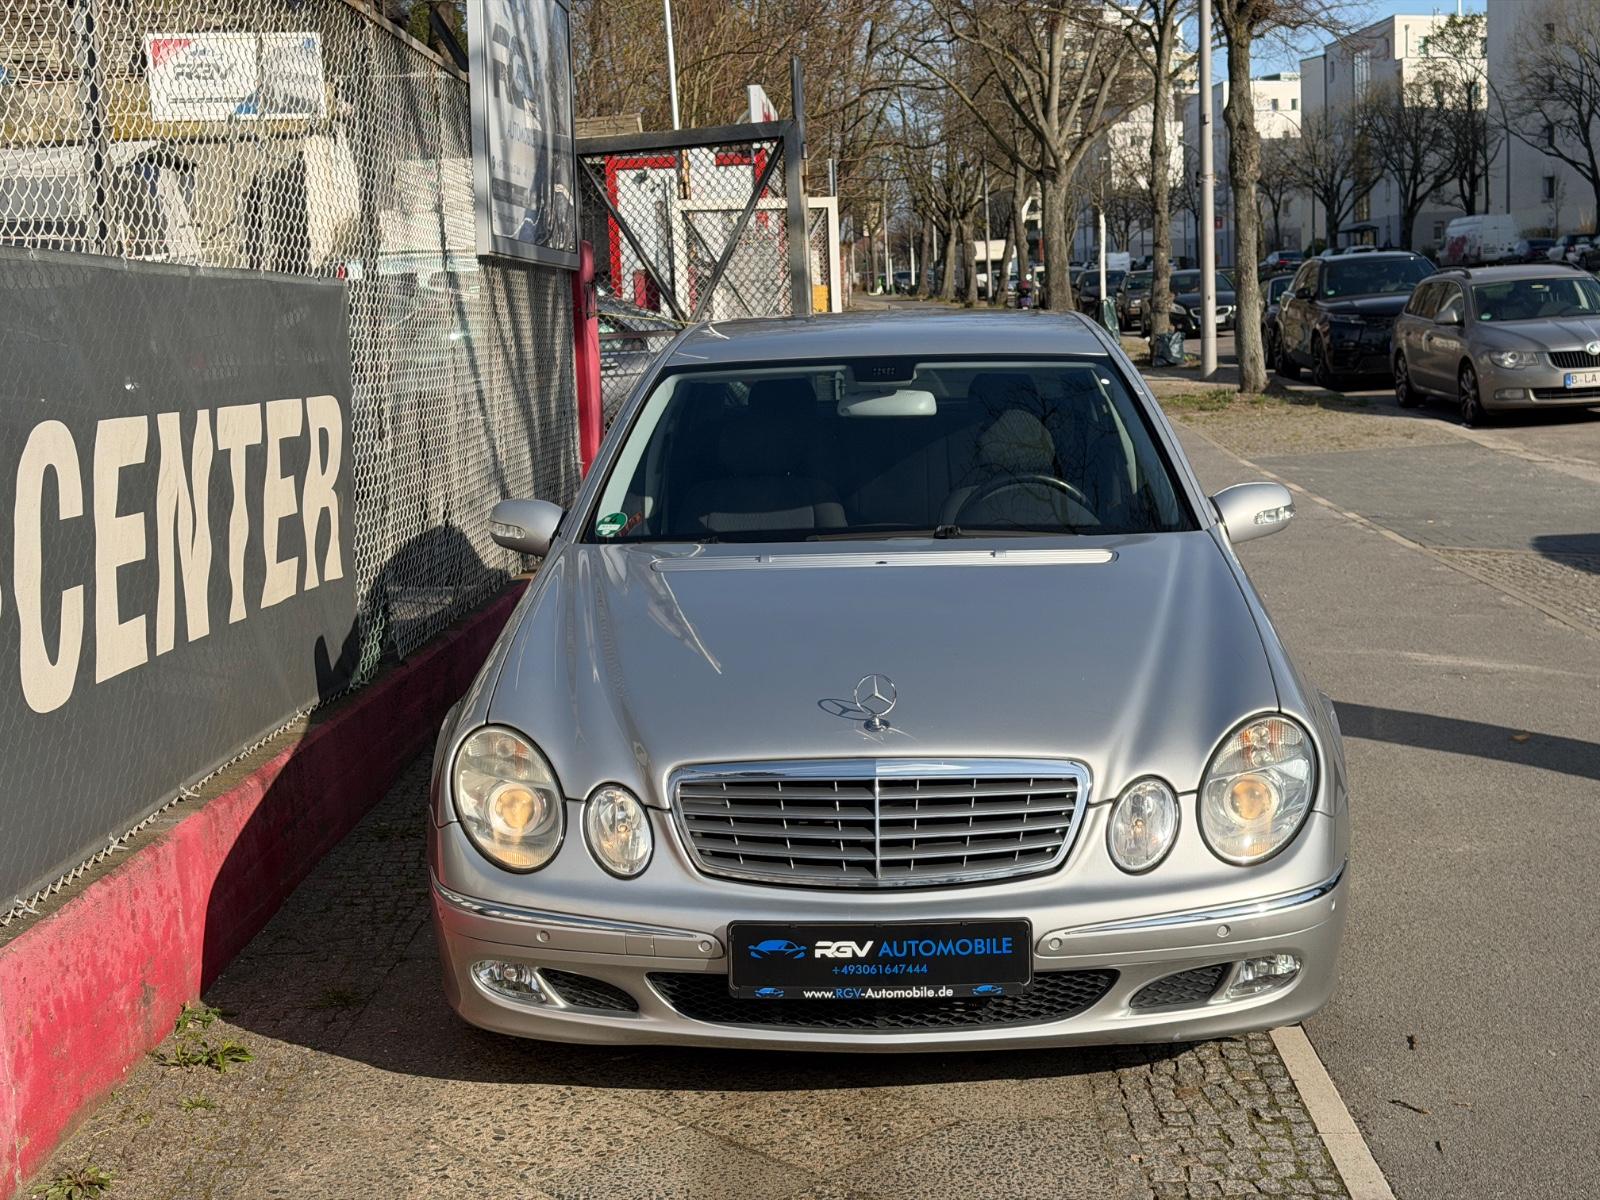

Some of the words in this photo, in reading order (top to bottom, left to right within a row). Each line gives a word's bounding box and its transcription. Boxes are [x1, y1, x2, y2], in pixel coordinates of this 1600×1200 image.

[14, 394, 344, 714] CENTER
[814, 940, 874, 958] RGV
[878, 937, 1013, 957] AUTOMOBILE
[832, 963, 928, 975] +493061647444
[803, 985, 954, 999] www.RGV-Automobile.de
